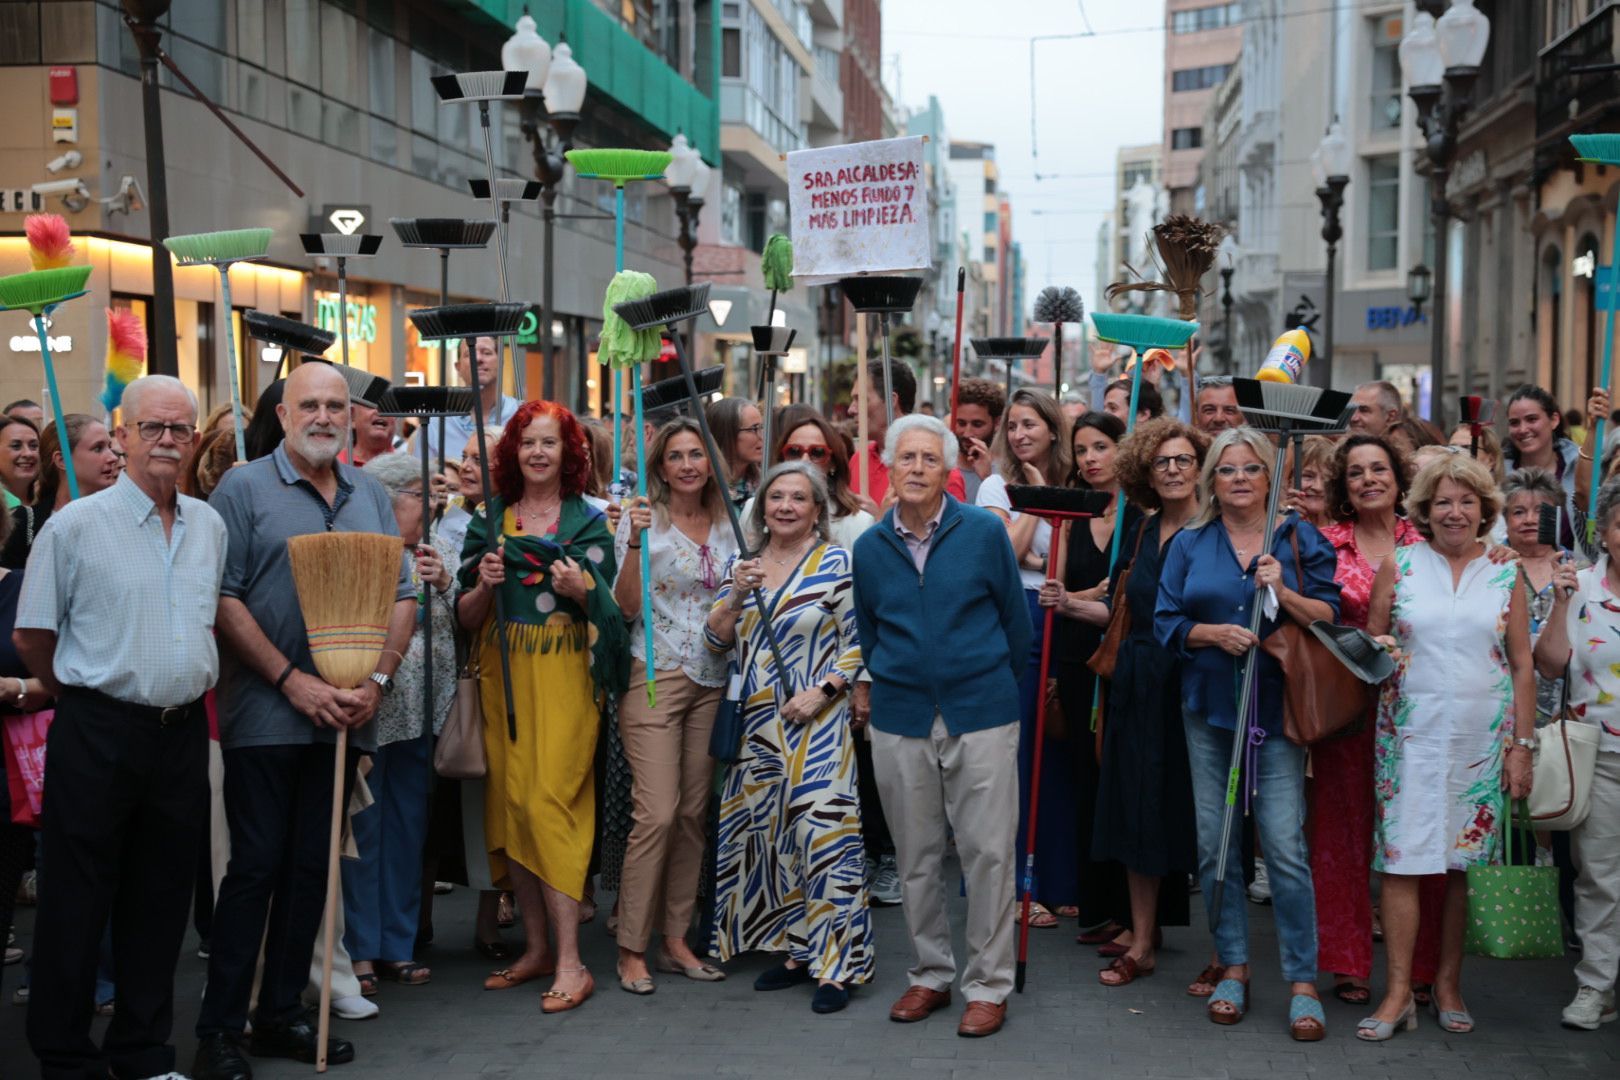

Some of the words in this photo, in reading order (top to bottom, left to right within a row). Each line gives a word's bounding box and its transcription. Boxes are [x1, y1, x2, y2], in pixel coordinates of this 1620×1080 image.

[811, 188, 858, 209] MENOS
[862, 185, 901, 204] RUIDO
[843, 203, 917, 228] LIMPIEZA.
